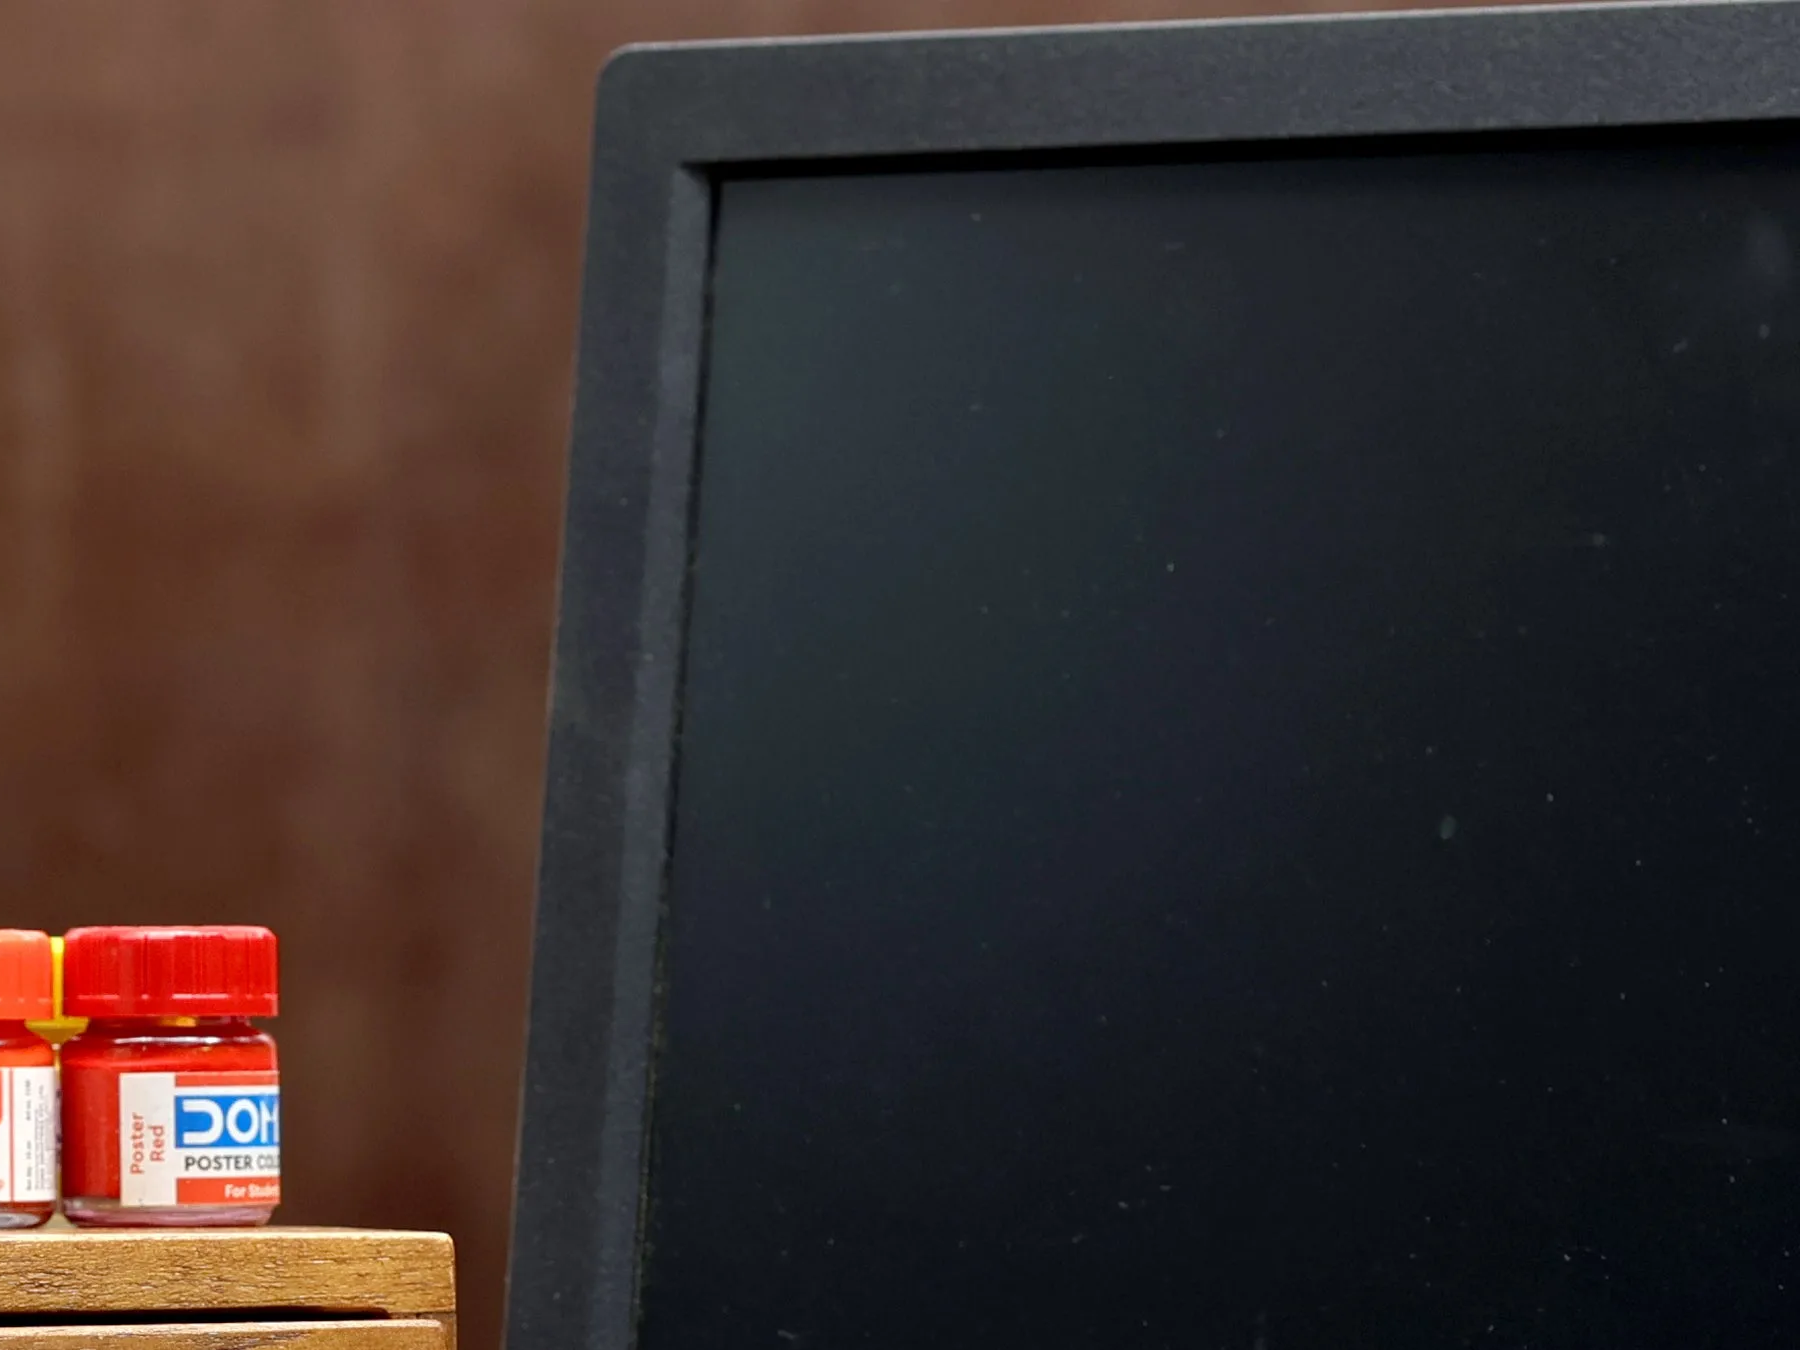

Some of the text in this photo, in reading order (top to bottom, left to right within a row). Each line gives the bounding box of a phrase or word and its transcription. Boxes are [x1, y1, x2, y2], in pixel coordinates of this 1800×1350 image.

[130, 1111, 145, 1175] Poster
[148, 1125, 165, 1162] Red
[184, 1154, 253, 1172] POSTER
